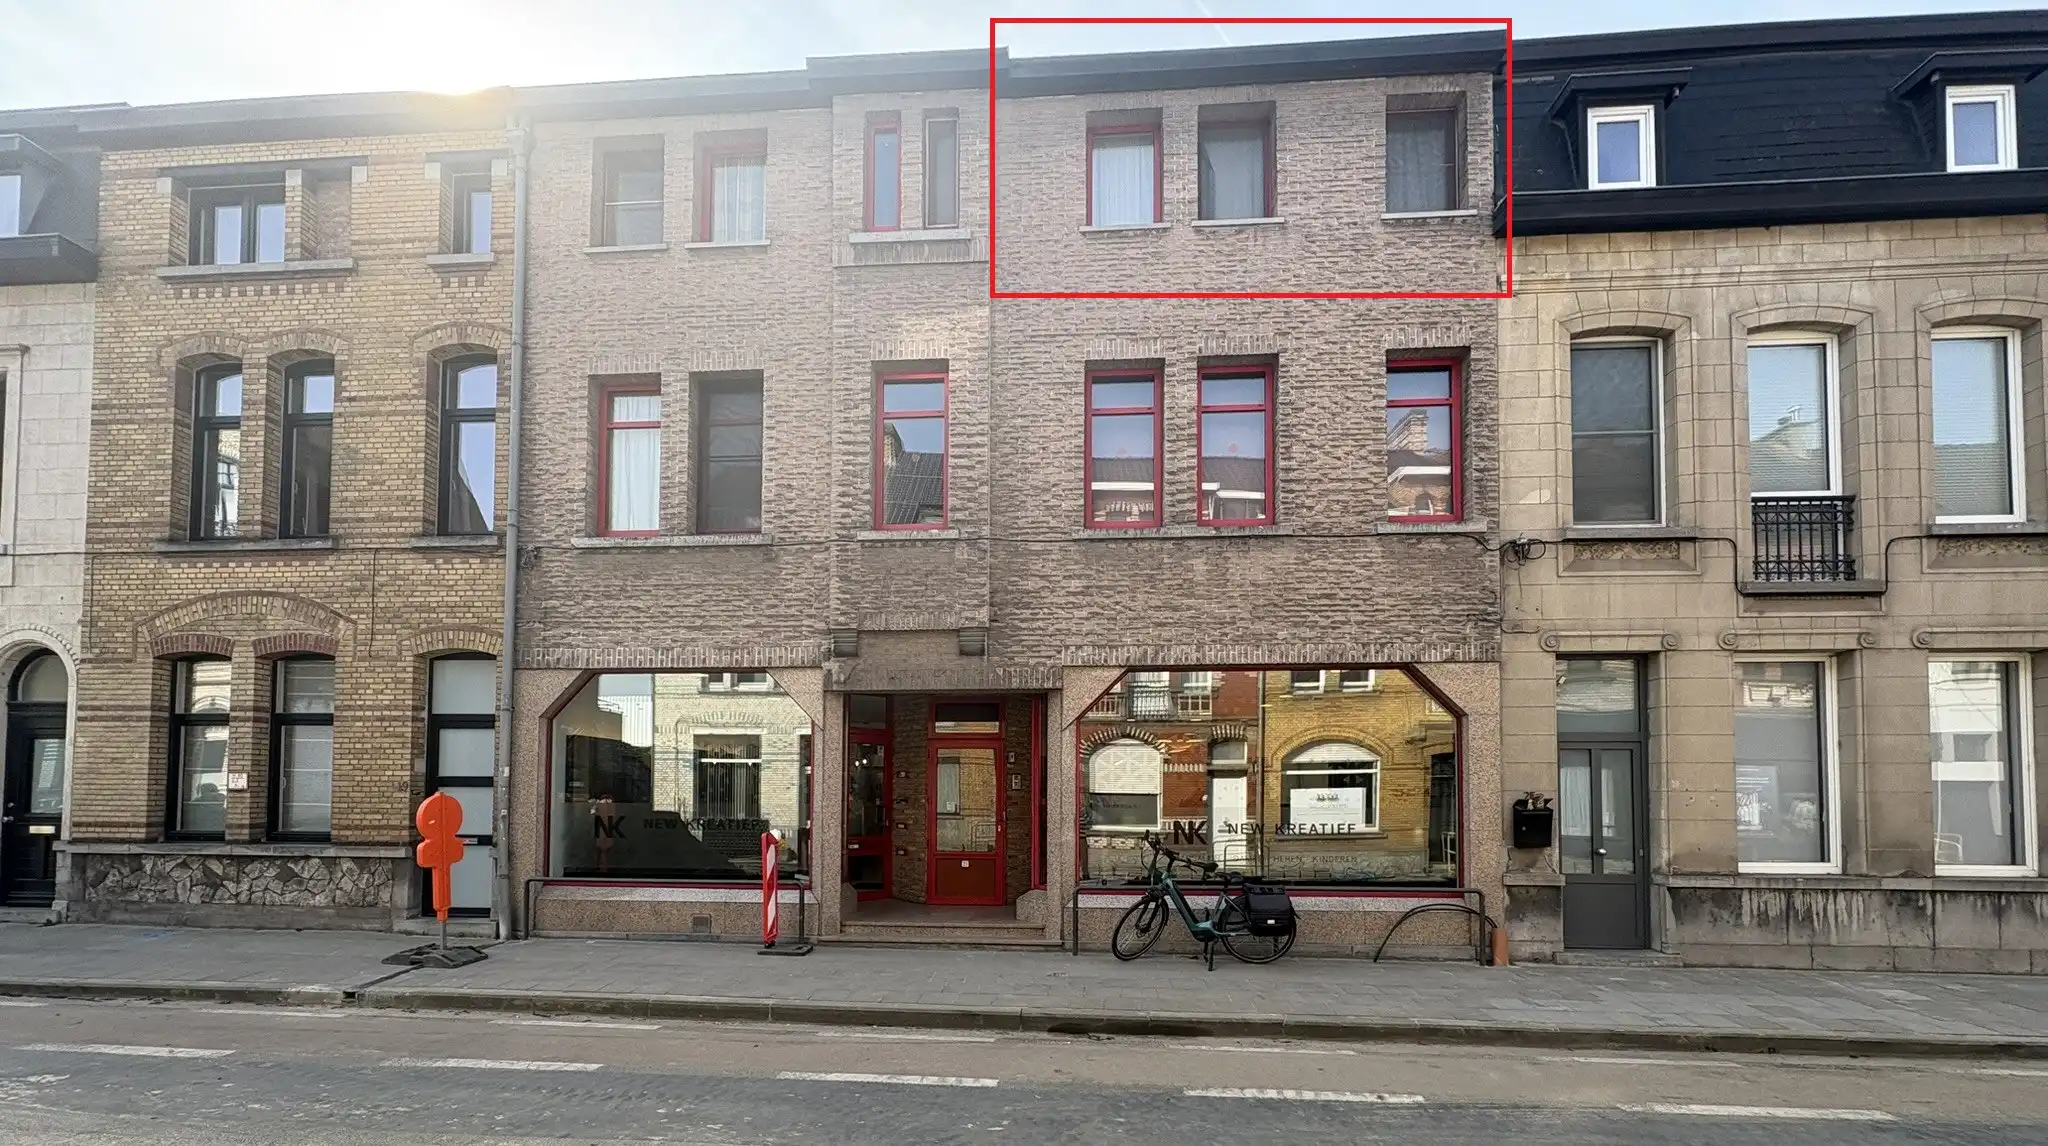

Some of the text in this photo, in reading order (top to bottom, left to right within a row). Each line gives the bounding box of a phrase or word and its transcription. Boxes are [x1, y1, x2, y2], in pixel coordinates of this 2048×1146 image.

[594, 816, 627, 838] NK
[643, 818, 677, 830] NEW
[1173, 820, 1208, 844] NK
[1228, 823, 1356, 834] NEW KREATIEF
